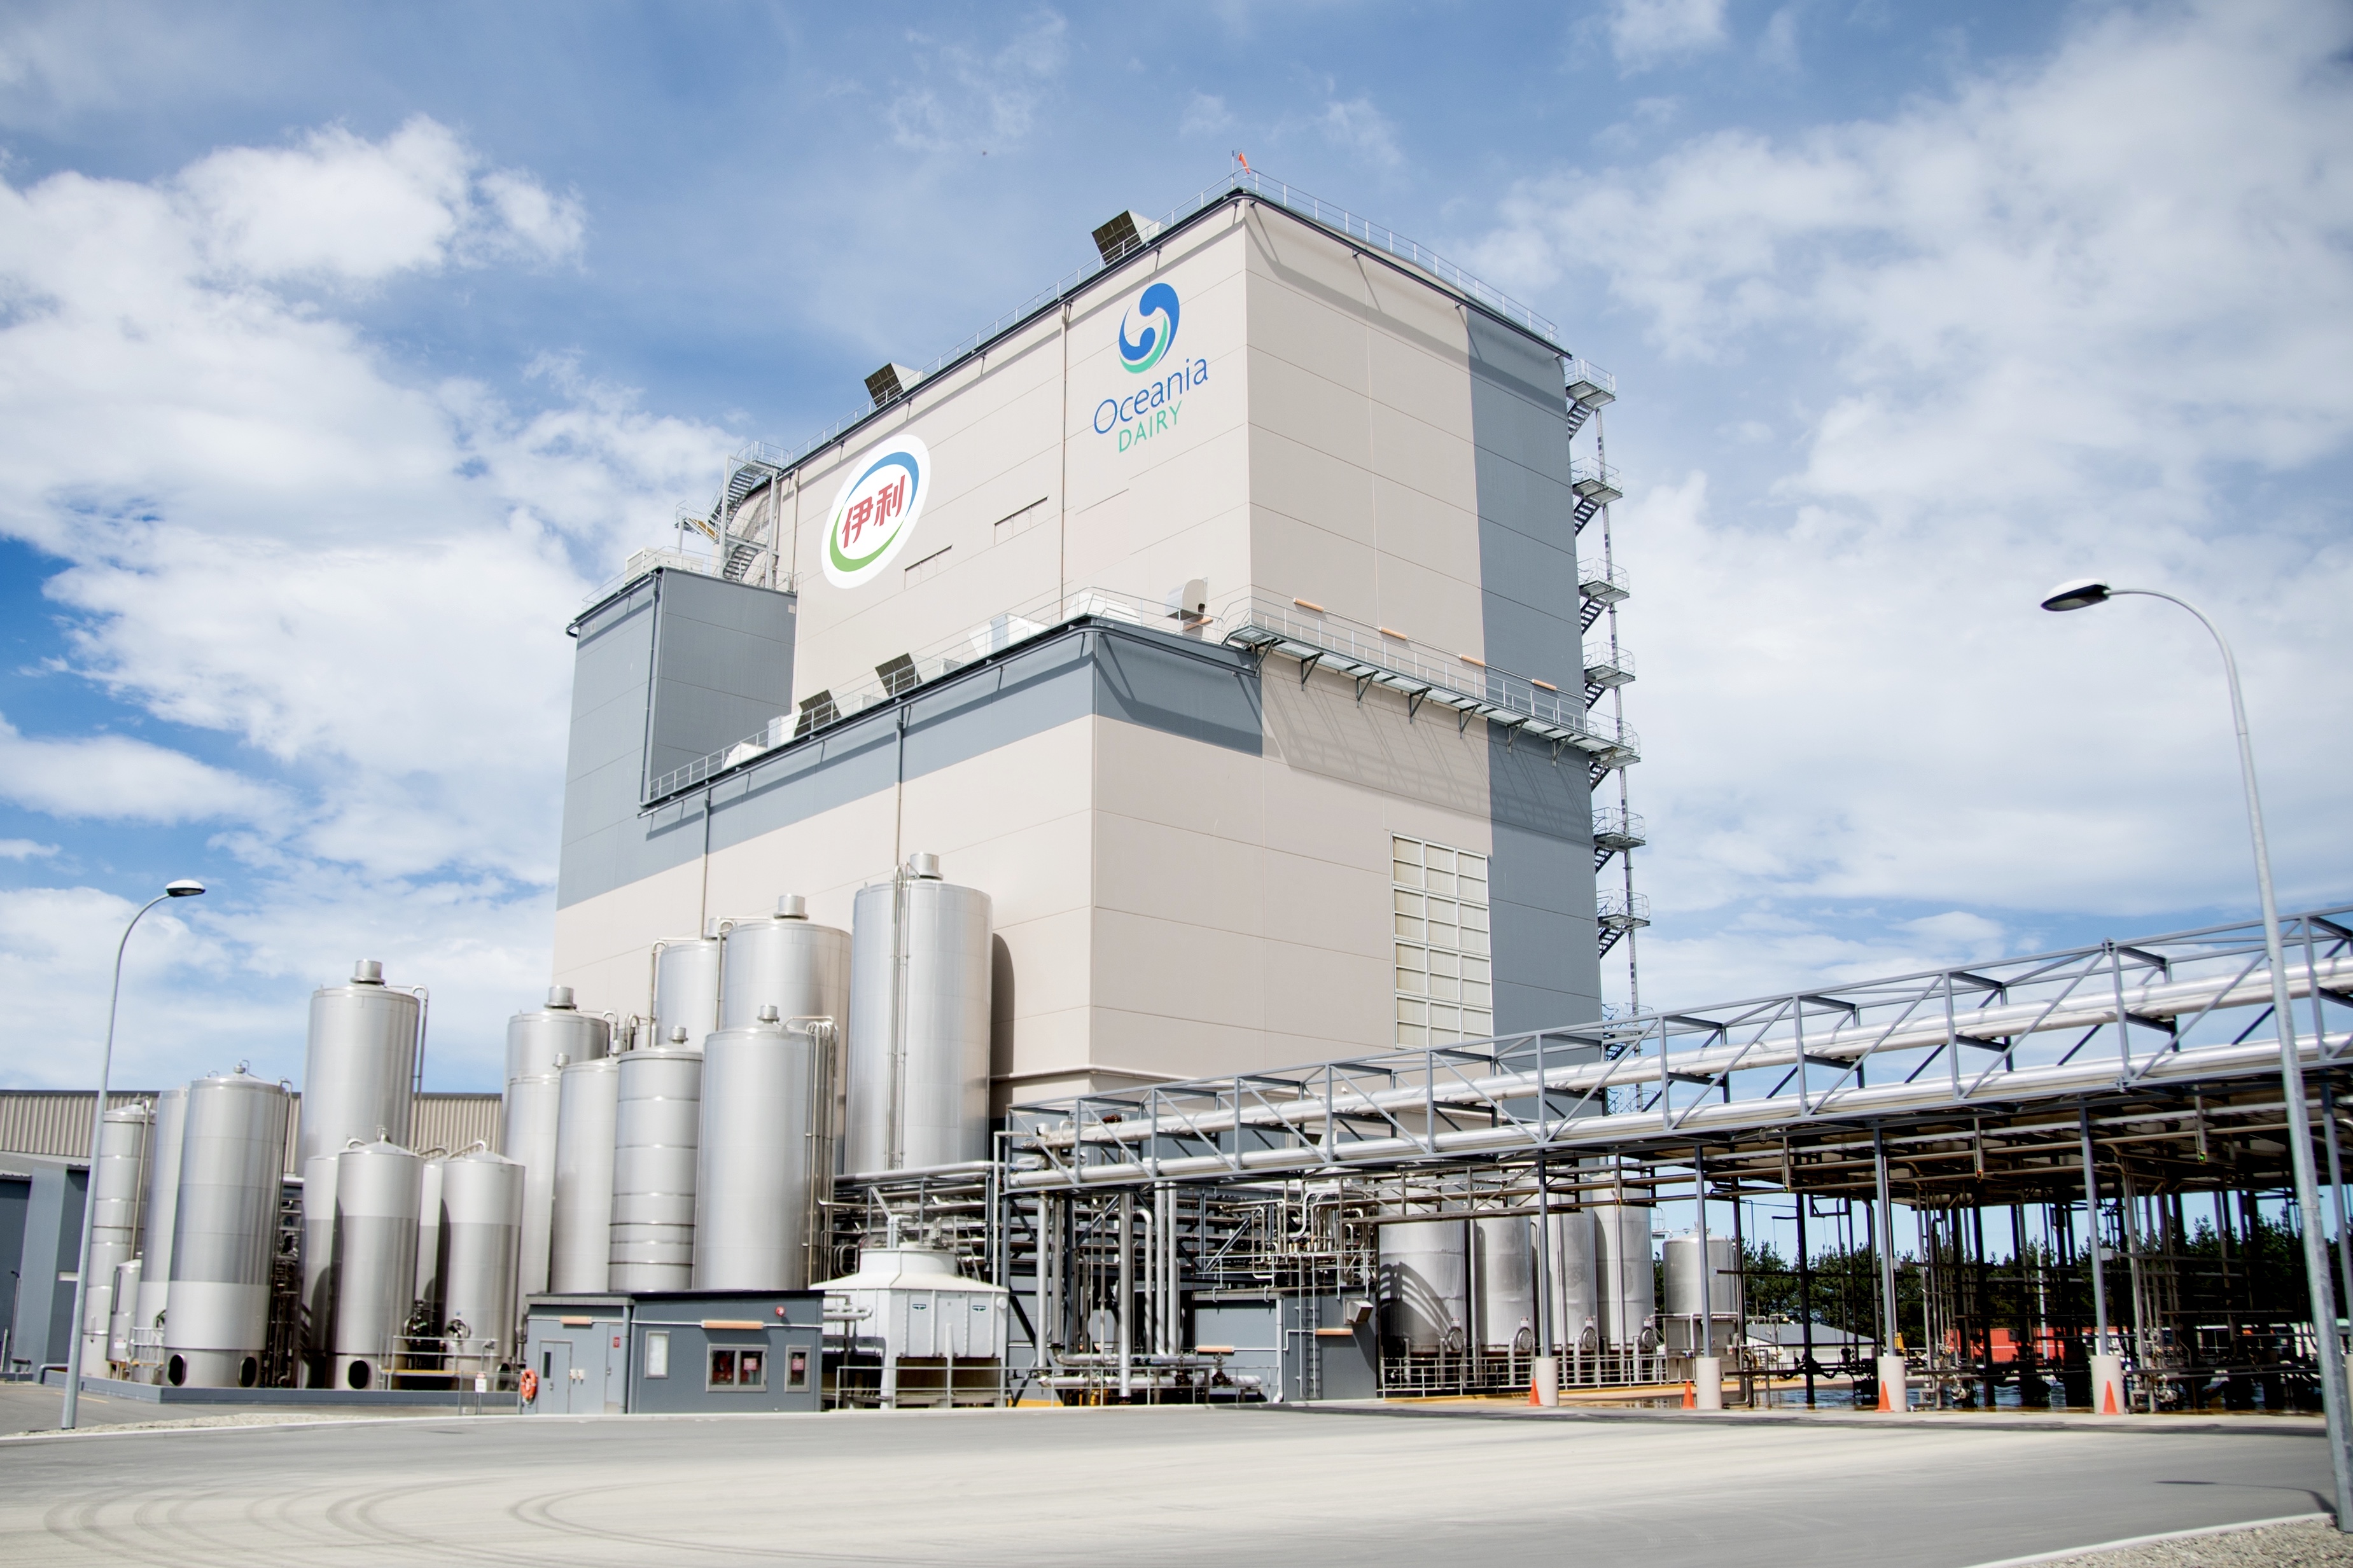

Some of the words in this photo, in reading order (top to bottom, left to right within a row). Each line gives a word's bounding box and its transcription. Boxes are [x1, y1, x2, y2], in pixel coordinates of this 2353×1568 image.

[1094, 358, 1209, 434] Oceania
[1119, 399, 1182, 453] DAIRY
[842, 475, 905, 548] 伊利
